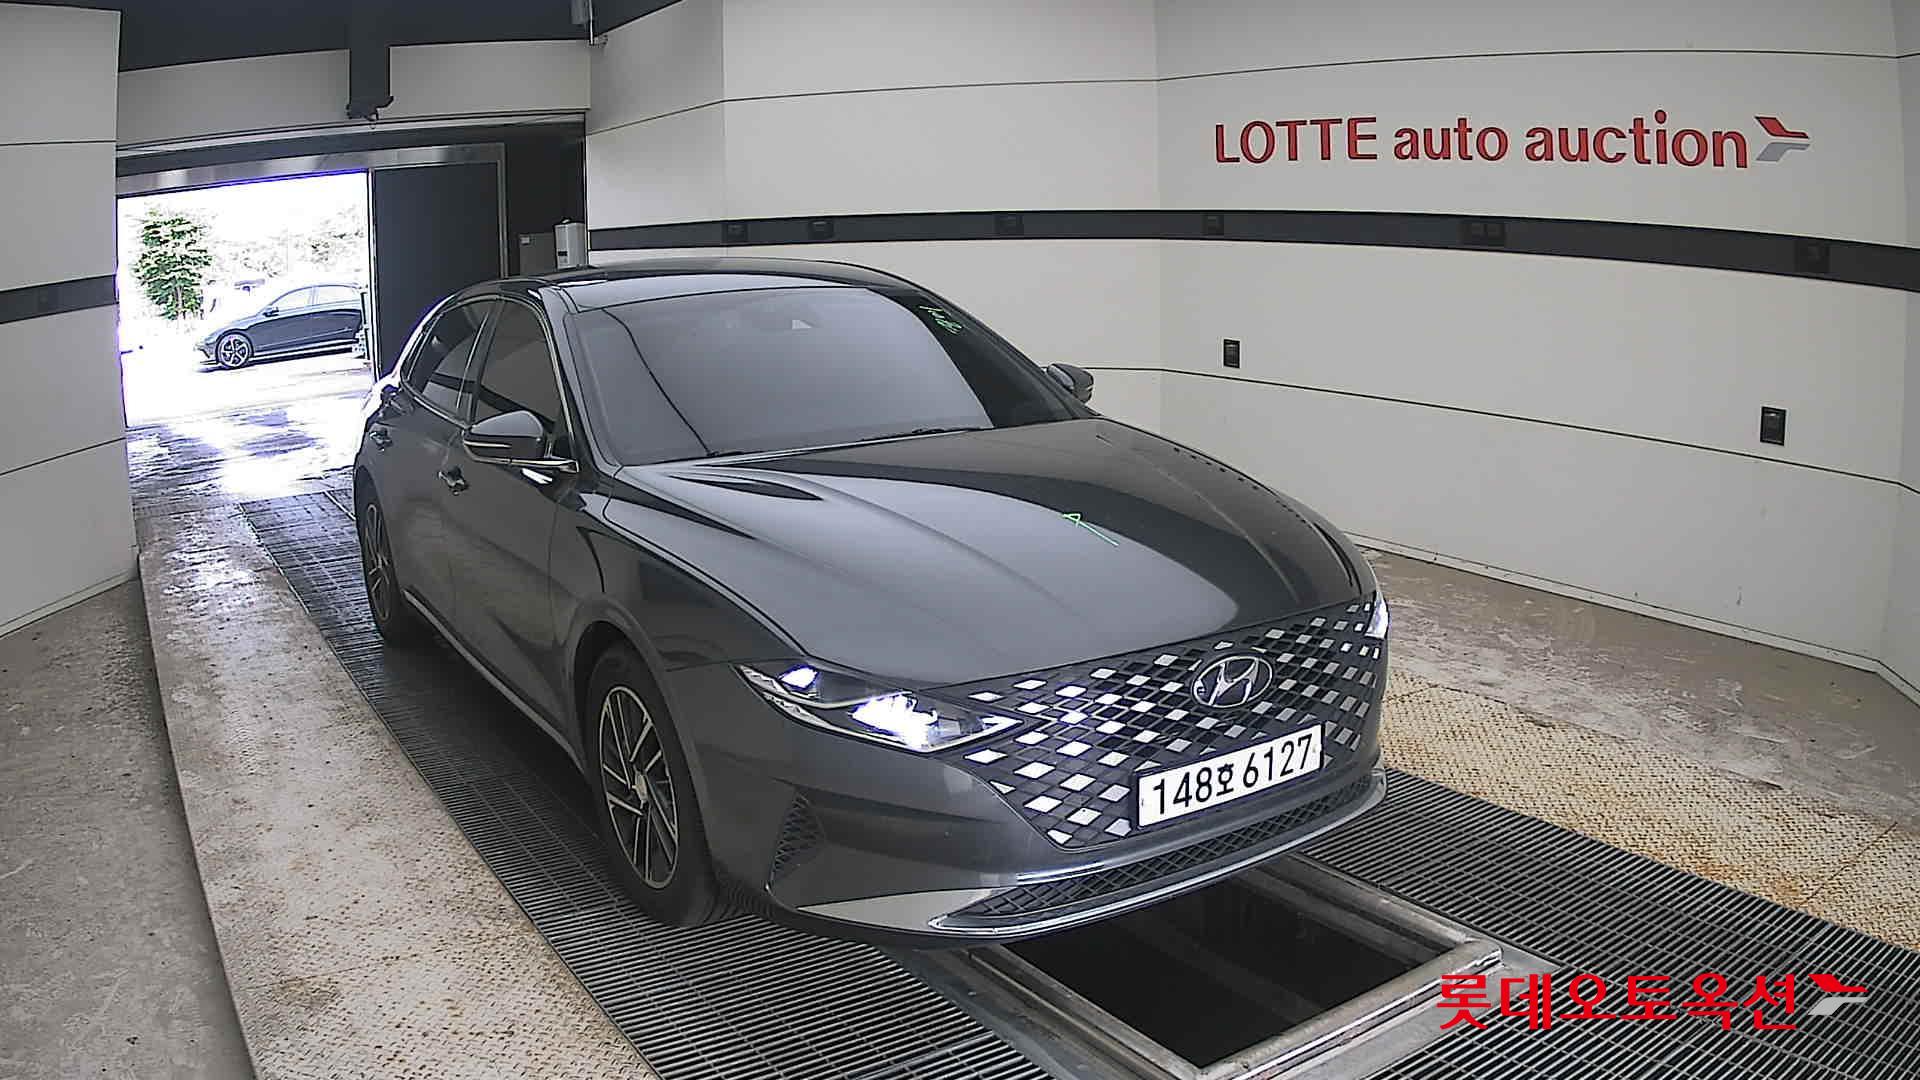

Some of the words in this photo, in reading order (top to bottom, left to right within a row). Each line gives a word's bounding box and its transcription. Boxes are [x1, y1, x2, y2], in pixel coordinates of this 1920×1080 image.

[1215, 116, 1377, 163] LOTTE
[1393, 117, 1509, 162] auto
[1524, 109, 1748, 168] auction
[1153, 763, 1235, 815] 148호
[1242, 734, 1313, 788] 6127
